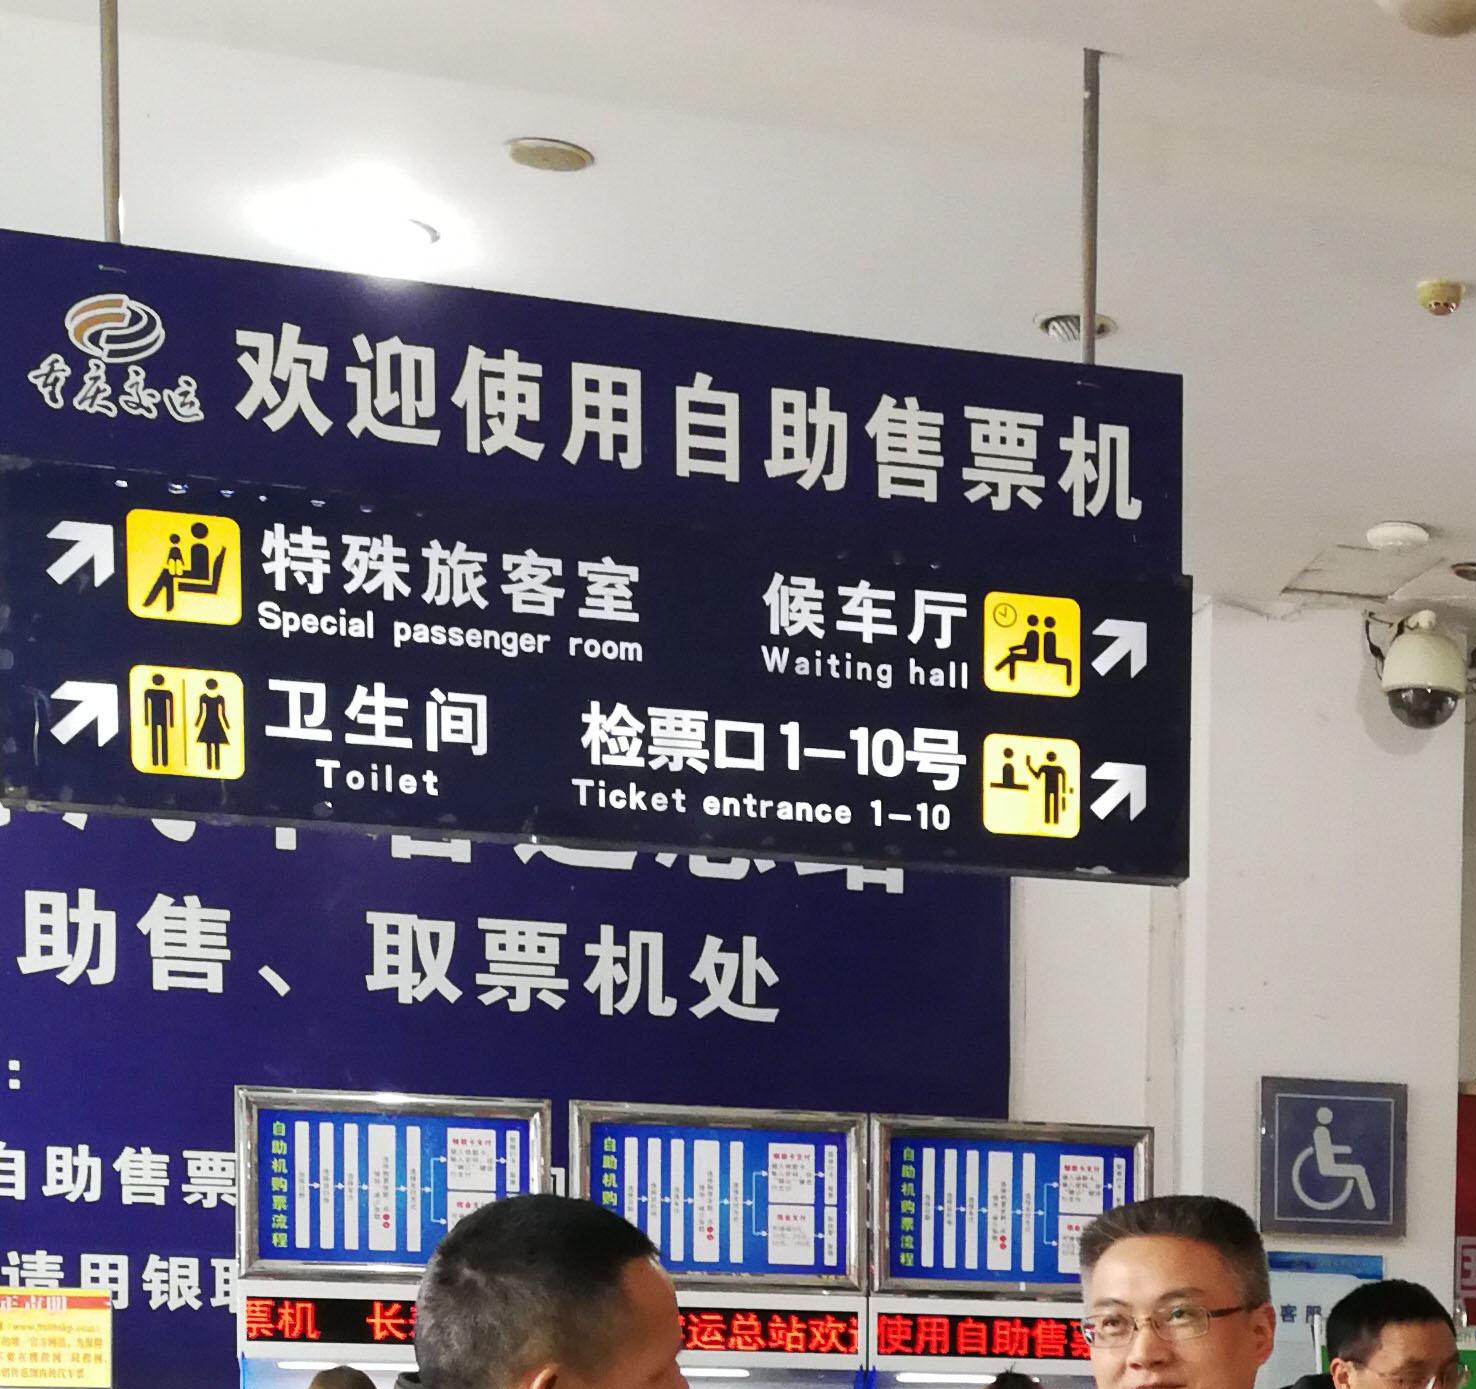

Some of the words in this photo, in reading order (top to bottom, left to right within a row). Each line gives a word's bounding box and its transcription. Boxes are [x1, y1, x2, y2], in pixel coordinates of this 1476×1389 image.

[235, 322, 1143, 521] 欢迎使用自助售票机
[260, 522, 641, 624] 特殊旅客室
[257, 600, 375, 640] Special
[393, 618, 551, 658] passenger
[569, 634, 643, 662] room
[762, 572, 968, 650] 候车厅
[760, 645, 894, 690] Waiting
[909, 656, 968, 691] hall
[264, 678, 488, 756] 卫生间
[315, 758, 439, 797] Toilet
[571, 778, 686, 814] Ticket
[702, 792, 852, 826] entrance
[602, 1138, 618, 1207] 自助机购
[366, 1301, 416, 1341] 长
[678, 1312, 859, 1354] 运总站欢
